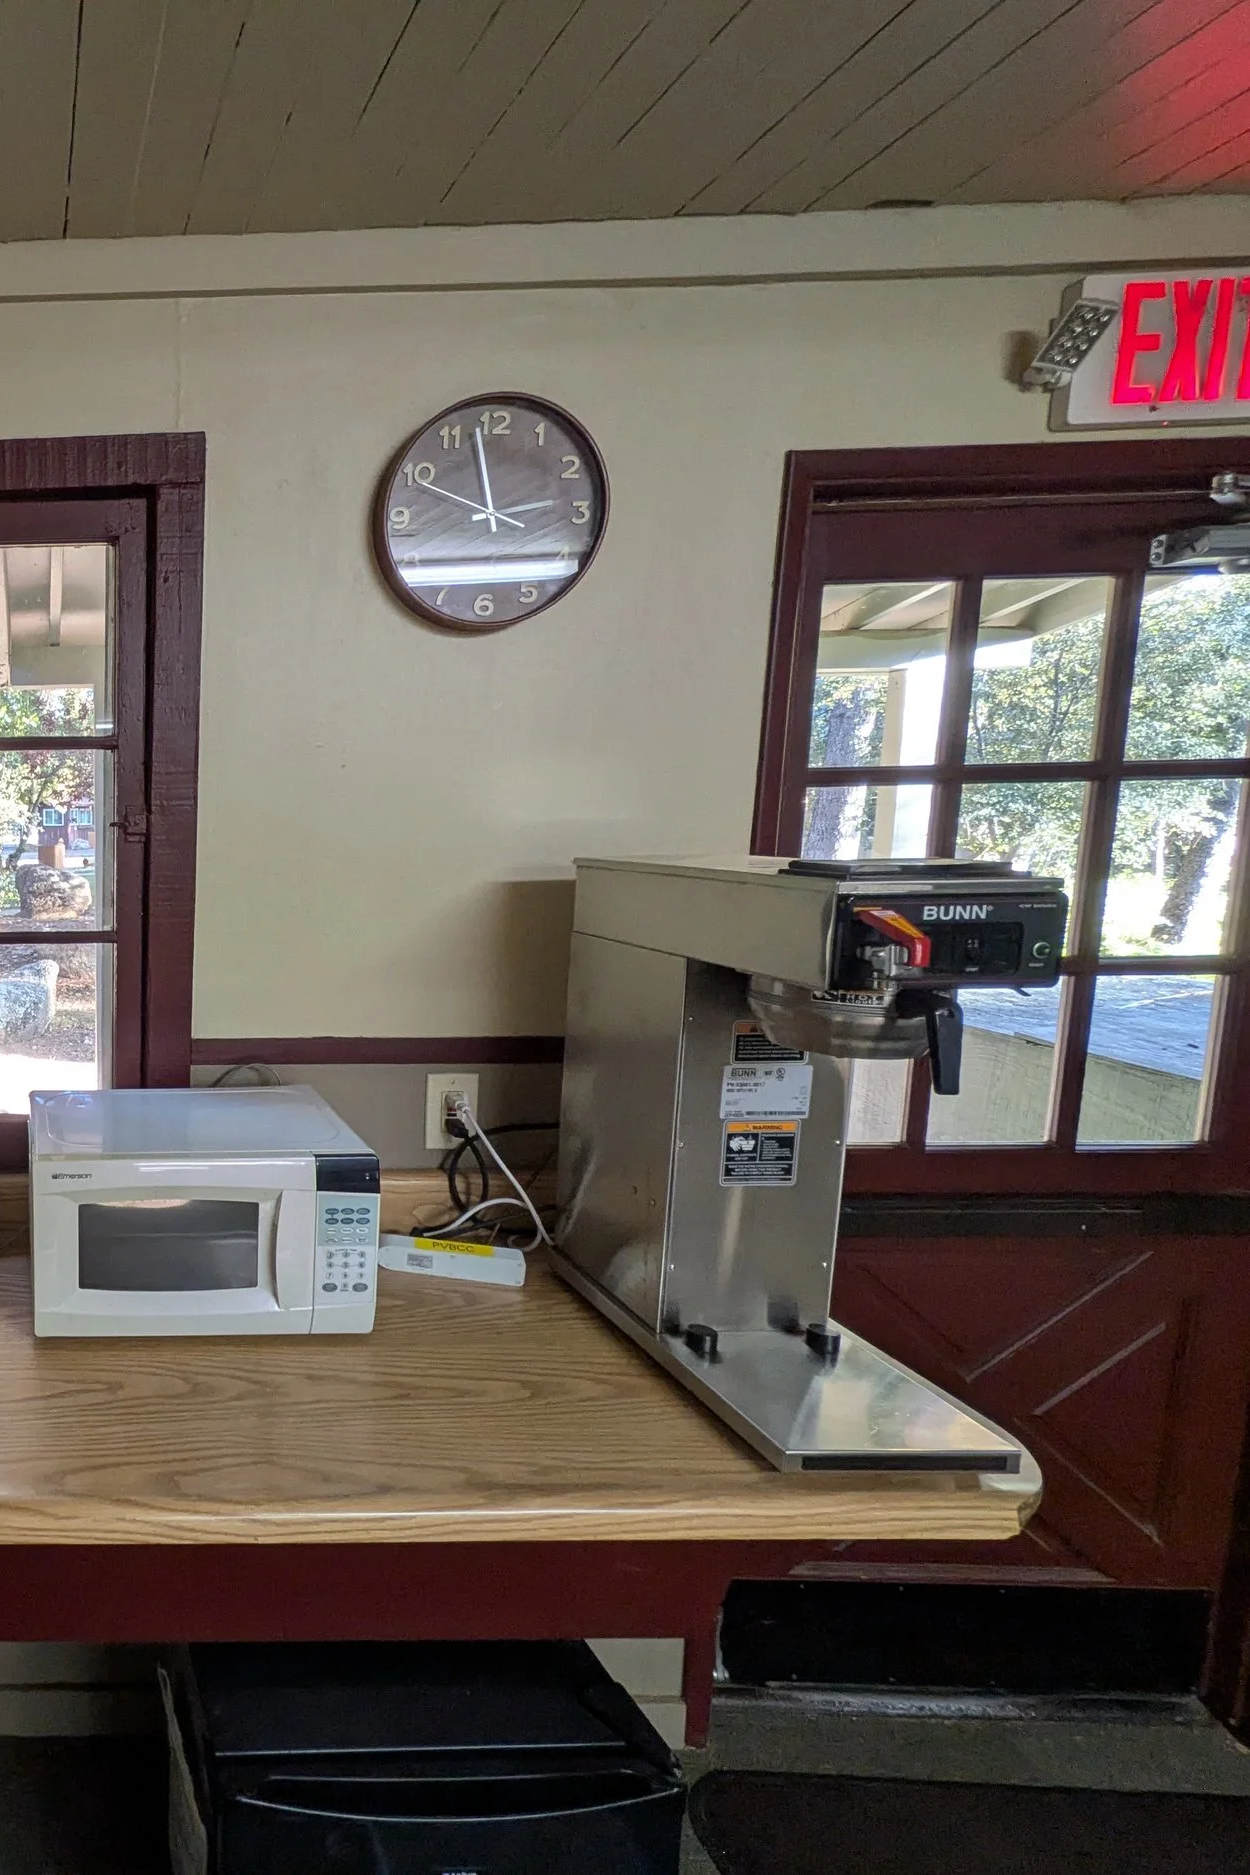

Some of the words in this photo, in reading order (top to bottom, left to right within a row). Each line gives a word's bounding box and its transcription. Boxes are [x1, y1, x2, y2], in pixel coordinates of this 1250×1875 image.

[479, 411, 511, 435] 12
[535, 422, 545, 446] 1
[439, 425, 461, 449] 11
[403, 462, 436, 486] 10
[560, 455, 580, 479] 2
[390, 507, 410, 529] 9
[570, 501, 590, 524] 3
[519, 583, 538, 603] 5
[473, 594, 494, 616] 6
[923, 905, 987, 921] BUNN
[731, 1068, 756, 1078] BUNN
[432, 1241, 475, 1253] PVBCC
